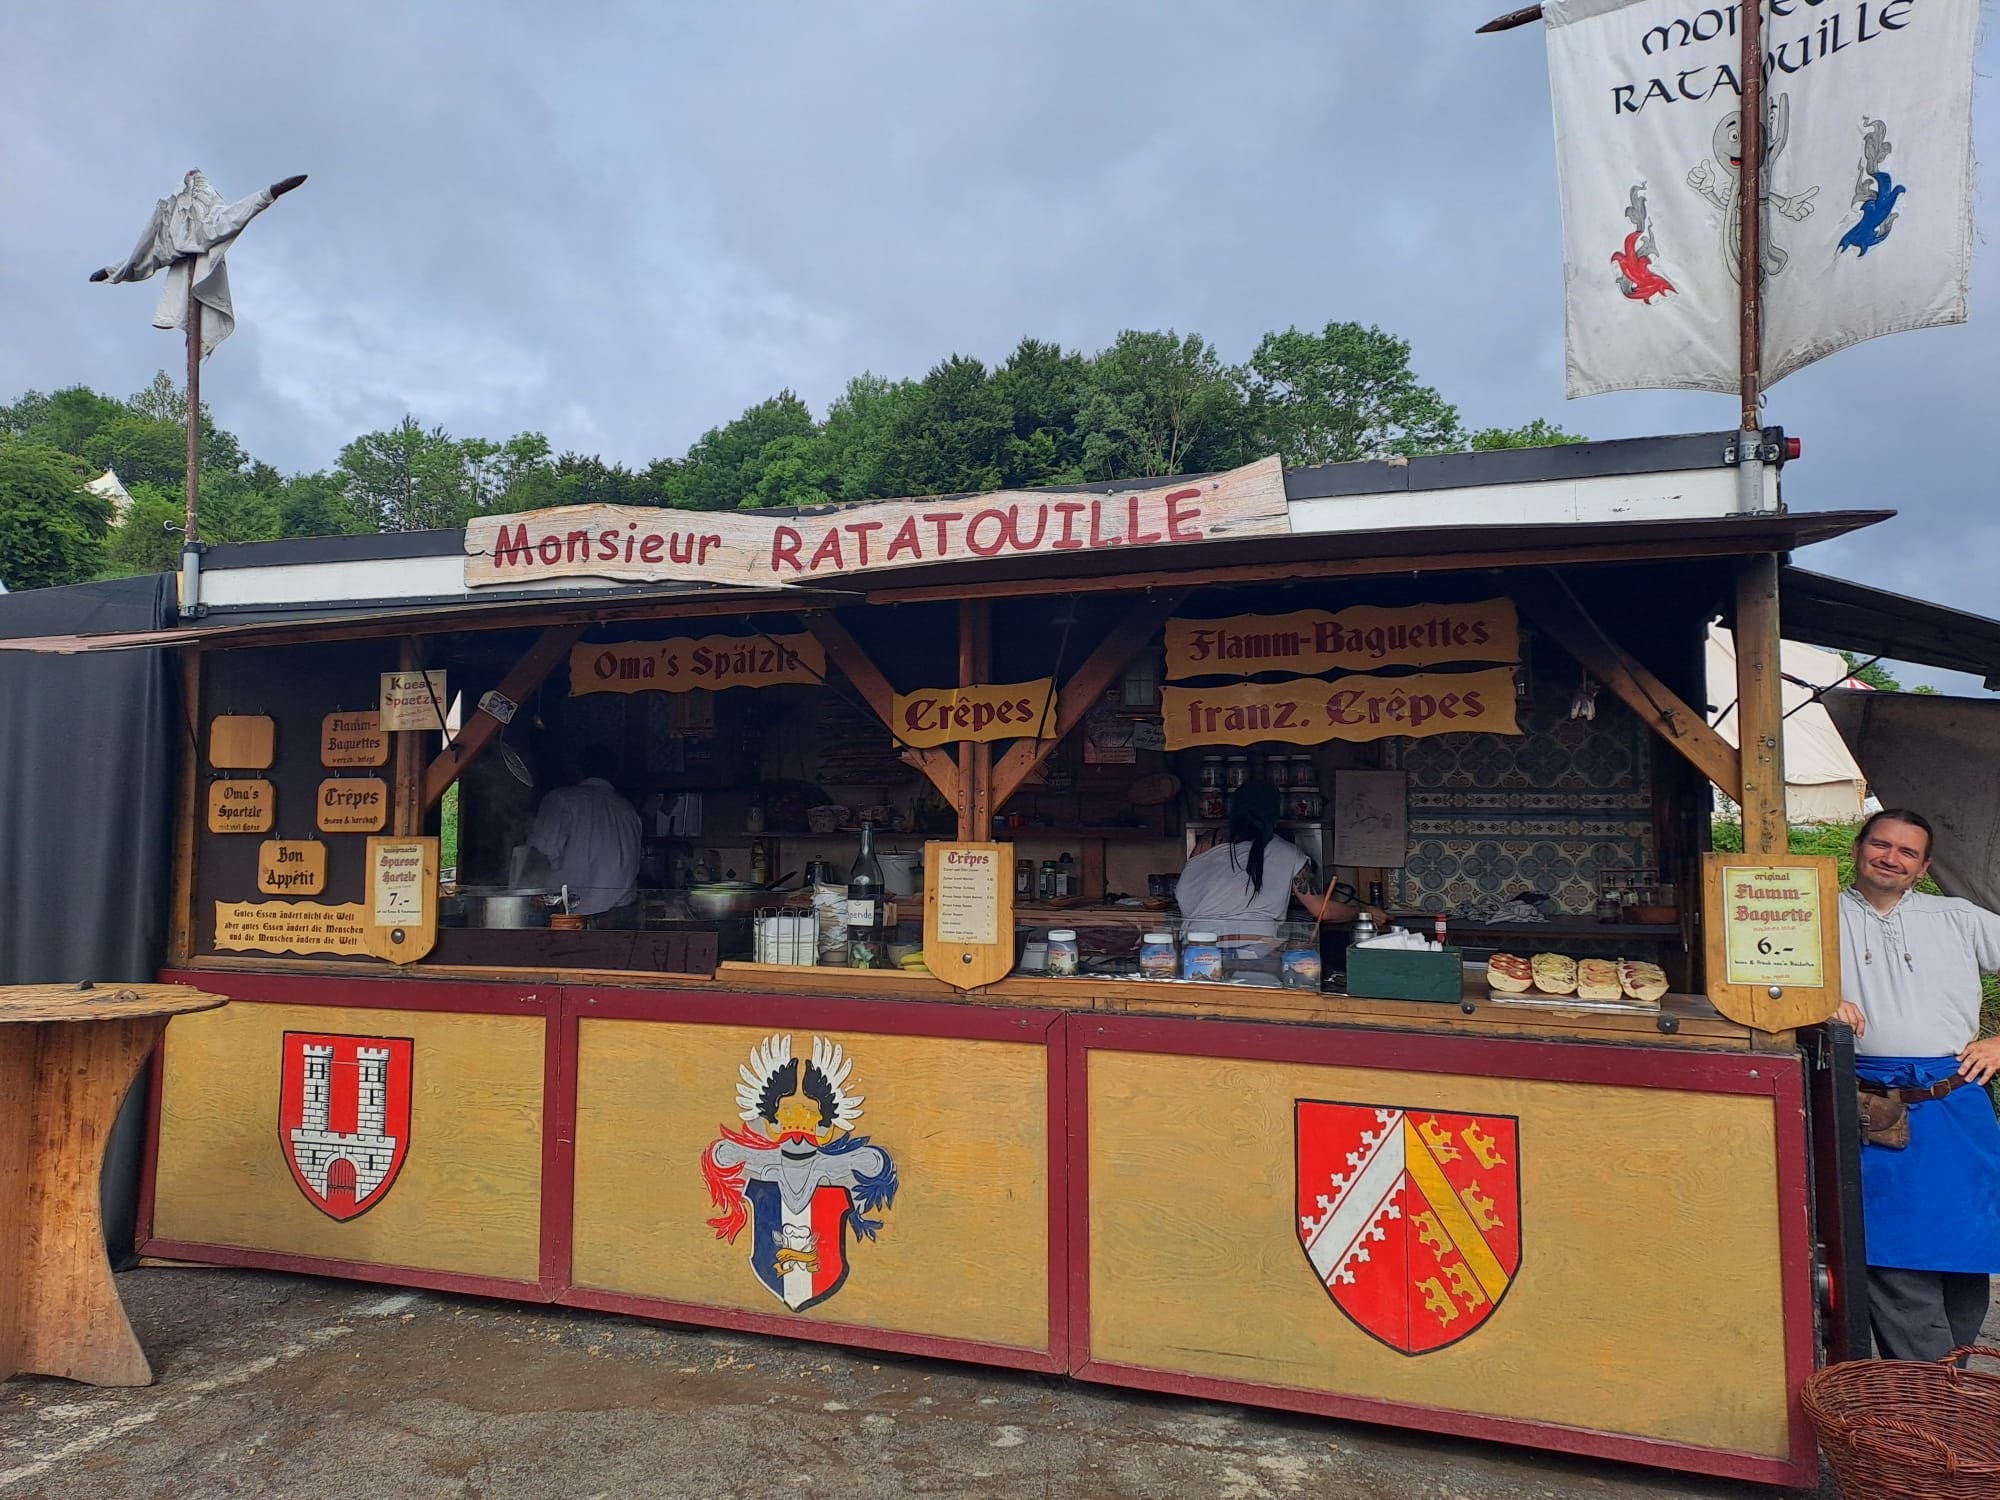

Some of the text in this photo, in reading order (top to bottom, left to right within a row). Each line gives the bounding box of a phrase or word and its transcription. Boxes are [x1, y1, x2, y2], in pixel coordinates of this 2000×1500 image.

[494, 488, 1204, 573] Monsieur RATATOUILLE
[1189, 616, 1490, 662] Flamm-Baguettes
[594, 643, 799, 681] Oma's Spätzle
[904, 696, 1035, 733] Crêpes
[1189, 699, 1311, 735] franz.
[1326, 688, 1486, 728] Crêpes
[332, 718, 378, 733] Flamm-
[328, 737, 381, 752] Baguettes
[224, 786, 260, 800] Oma's
[325, 788, 379, 810] Crêpes
[218, 804, 262, 821] Spaetzle
[277, 846, 304, 863] Bon
[948, 851, 990, 867] Crêpes
[265, 869, 314, 889] Appétit
[1754, 872, 1790, 882] original
[1734, 884, 1811, 900] Flamm-
[234, 909, 254, 918] Gutes
[256, 910, 277, 918] Essen
[279, 910, 303, 919] ändert
[304, 912, 321, 920] nicht
[336, 912, 355, 921] Welt
[848, 907, 873, 921] pende
[1734, 905, 1813, 924] Baguette
[224, 921, 239, 930] aber
[263, 922, 284, 931] Essen
[286, 923, 309, 932] ändert
[311, 925, 322, 933] die
[326, 924, 364, 934] Menschen
[229, 933, 242, 941] und
[258, 934, 294, 943] Menschen
[296, 935, 321, 944] ändern
[324, 936, 335, 944] die
[339, 936, 358, 945] Welt
